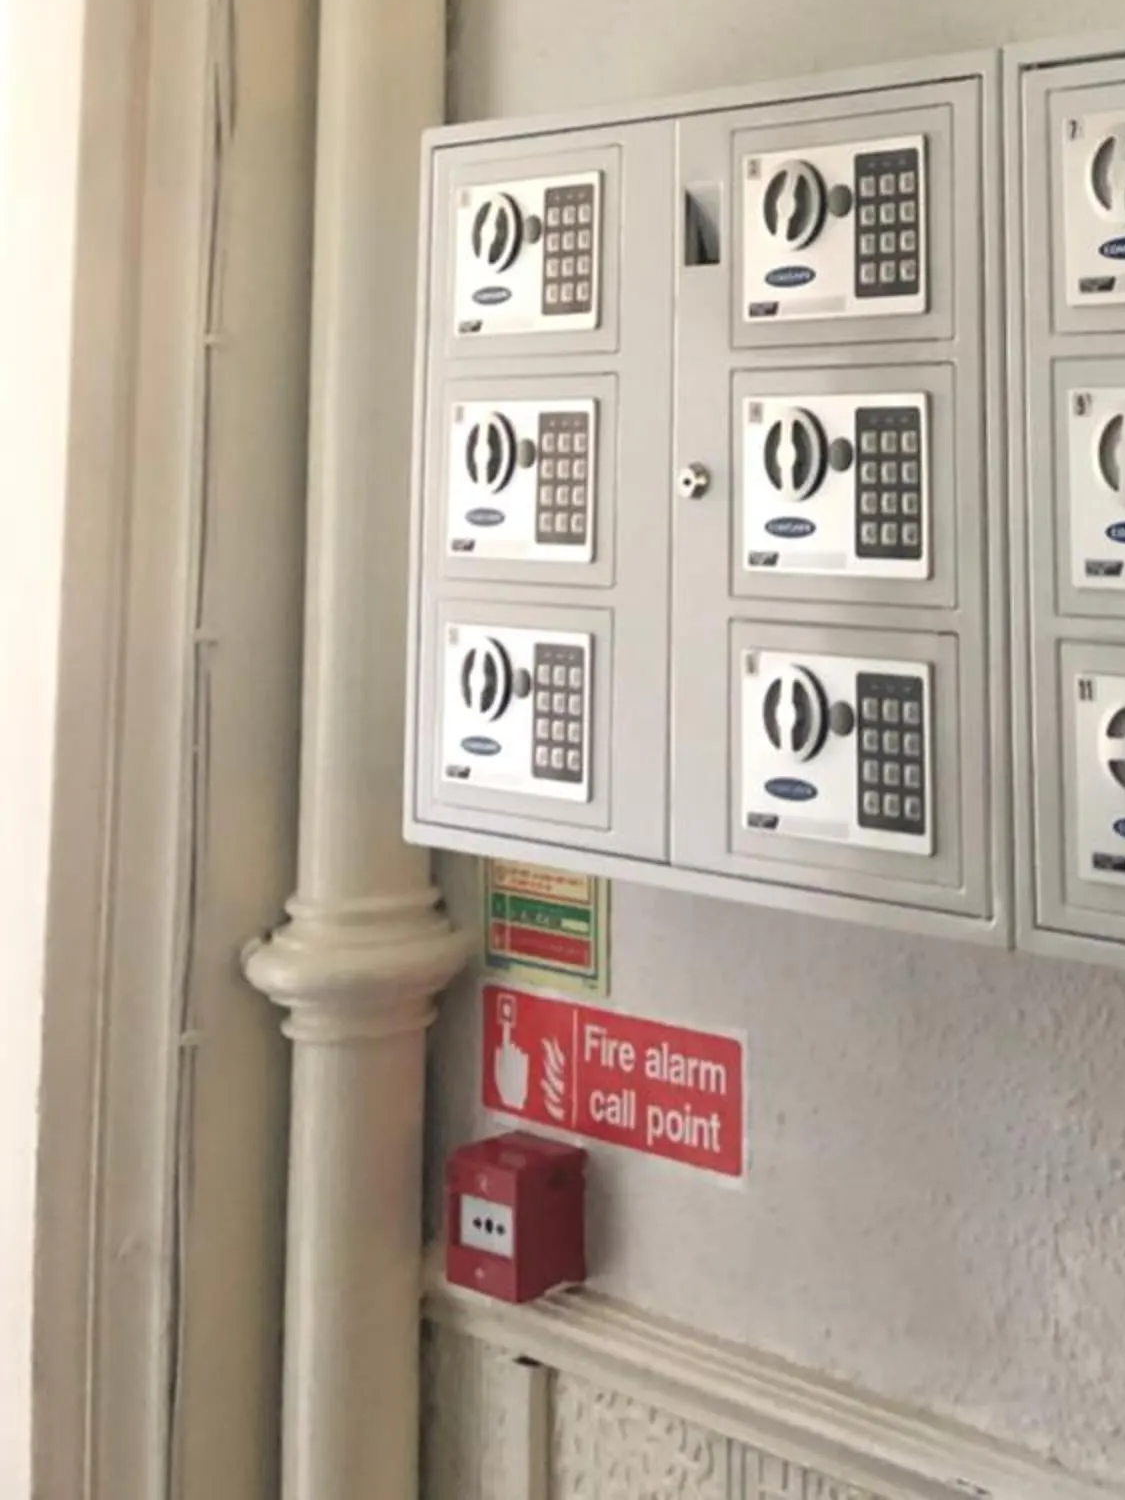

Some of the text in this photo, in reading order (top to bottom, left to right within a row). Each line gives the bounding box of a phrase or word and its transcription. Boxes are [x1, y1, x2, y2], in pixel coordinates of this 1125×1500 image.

[1078, 678, 1093, 701] 11
[584, 1025, 727, 1095] Fire alarm
[590, 1090, 722, 1153] call point
